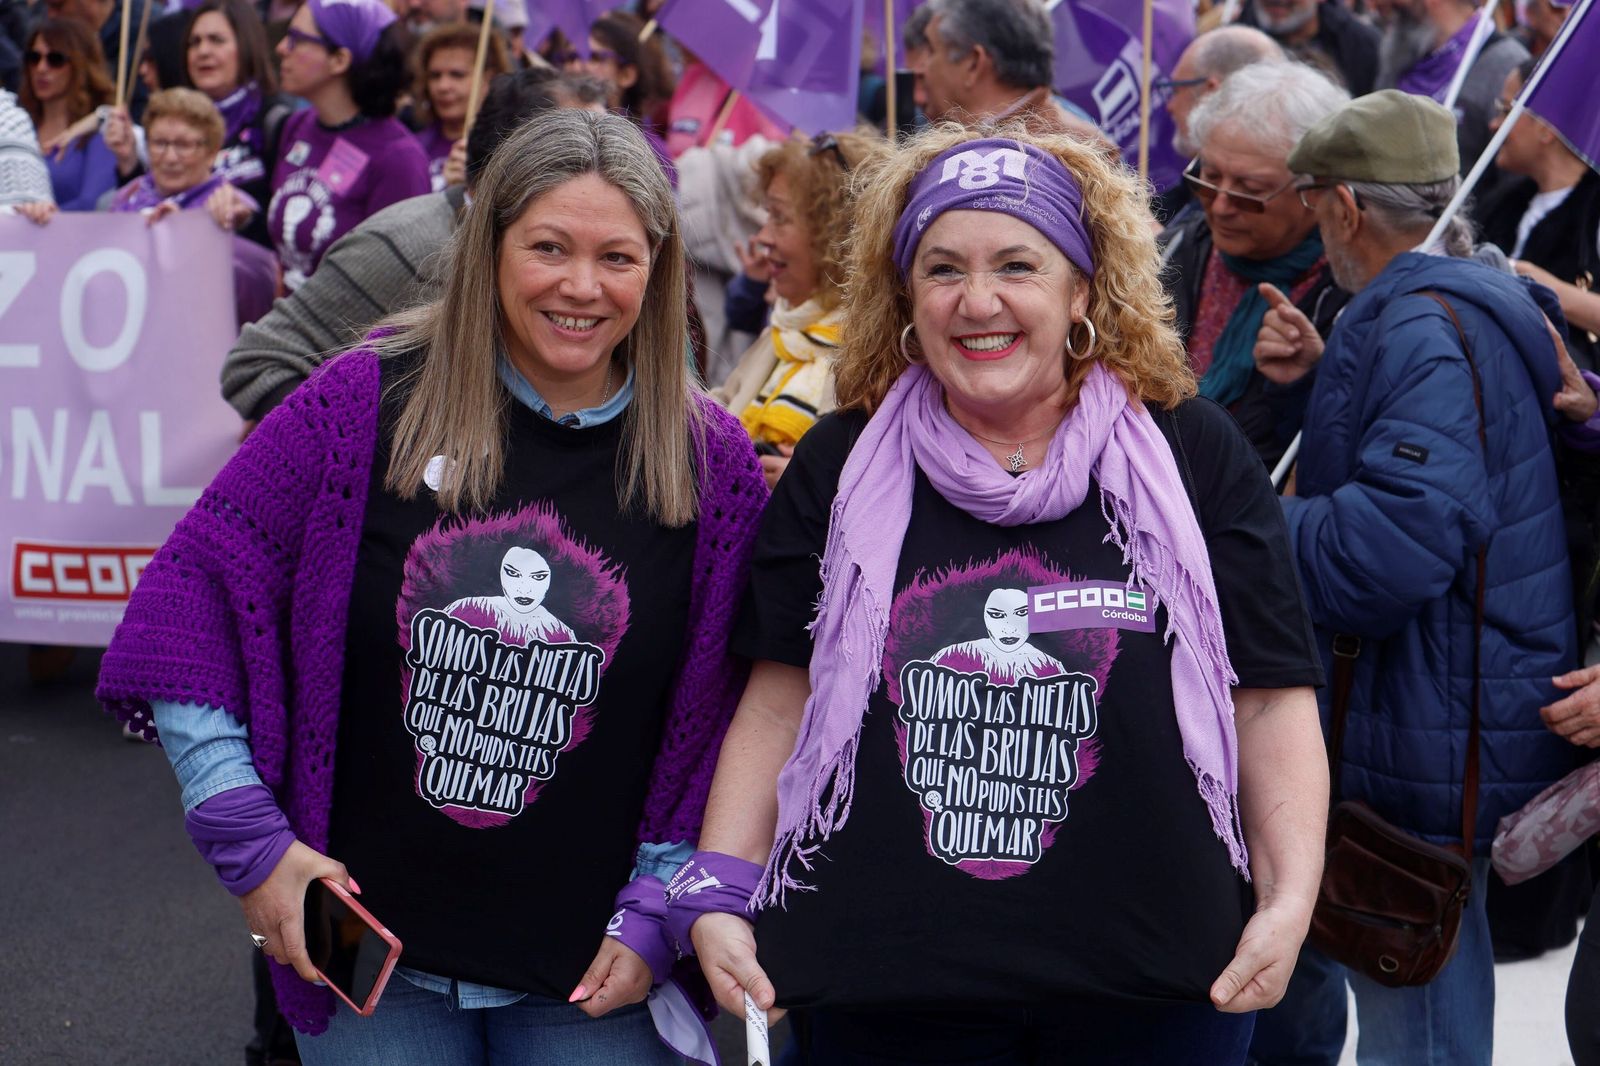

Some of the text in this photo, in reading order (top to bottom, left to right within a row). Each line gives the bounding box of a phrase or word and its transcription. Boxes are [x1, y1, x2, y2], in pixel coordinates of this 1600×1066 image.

[0, 406, 203, 506] NAL
[1034, 587, 1125, 613] CCOO
[1101, 609, 1148, 623] Córdoba
[413, 616, 599, 700] SOMOS LAS NIETAS
[411, 701, 445, 734] QUE
[439, 714, 474, 757] NO
[415, 668, 570, 745] DE LAS BRUJAS
[906, 668, 1091, 734] SOMOS LAS NIETAS
[913, 721, 1071, 784] DE LAS BRUJAS
[426, 756, 524, 810] QUEMAR
[912, 757, 945, 789] QUE
[945, 765, 978, 808] NO
[937, 810, 1037, 857] QUEMAR
